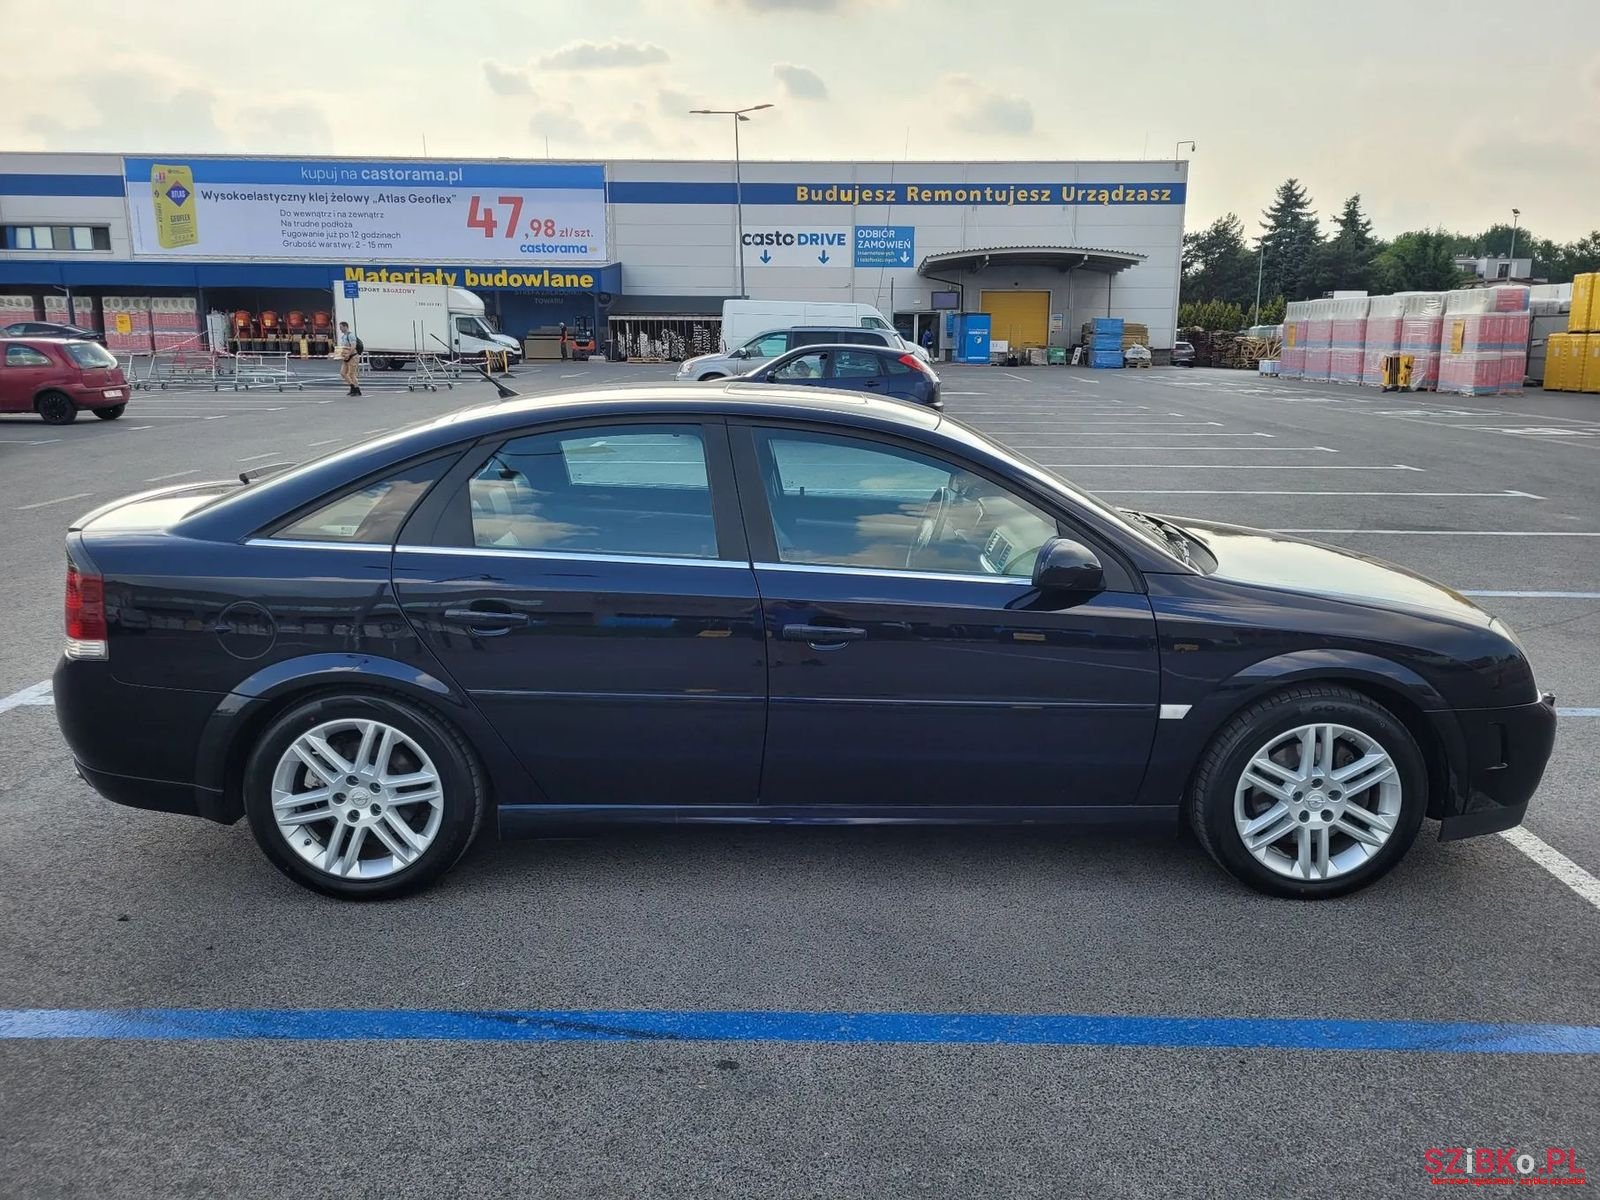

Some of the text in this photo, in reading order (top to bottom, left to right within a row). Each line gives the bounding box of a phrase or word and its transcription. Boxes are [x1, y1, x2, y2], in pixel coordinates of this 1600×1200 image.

[300, 167, 463, 184] kupuj na castorama.pl
[170, 190, 186, 198] ATLAS
[201, 190, 305, 203] Wysokoelastyczny
[309, 192, 328, 204] klej
[331, 192, 369, 205] żelowy
[796, 185, 1172, 206] Budujesz Remontujesz Urządzasz
[280, 209, 291, 217] Do
[294, 210, 331, 219] wewnątrz
[348, 211, 384, 219] zewnątrz
[281, 220, 352, 229] Na trudne podłoża
[282, 230, 324, 239] Fugowanie
[326, 231, 337, 240] już
[351, 231, 358, 239] 12
[361, 232, 400, 241] godzinach
[559, 228, 594, 238] zł/szt.
[742, 231, 846, 246] casto DRIVE
[857, 228, 895, 239] ODBIÓR
[283, 240, 317, 248] Grubość
[368, 241, 376, 249] 15
[520, 243, 588, 254] castorama
[857, 239, 911, 249] ZAMÓWIEŃ
[344, 267, 594, 288] Materiały budowlane
